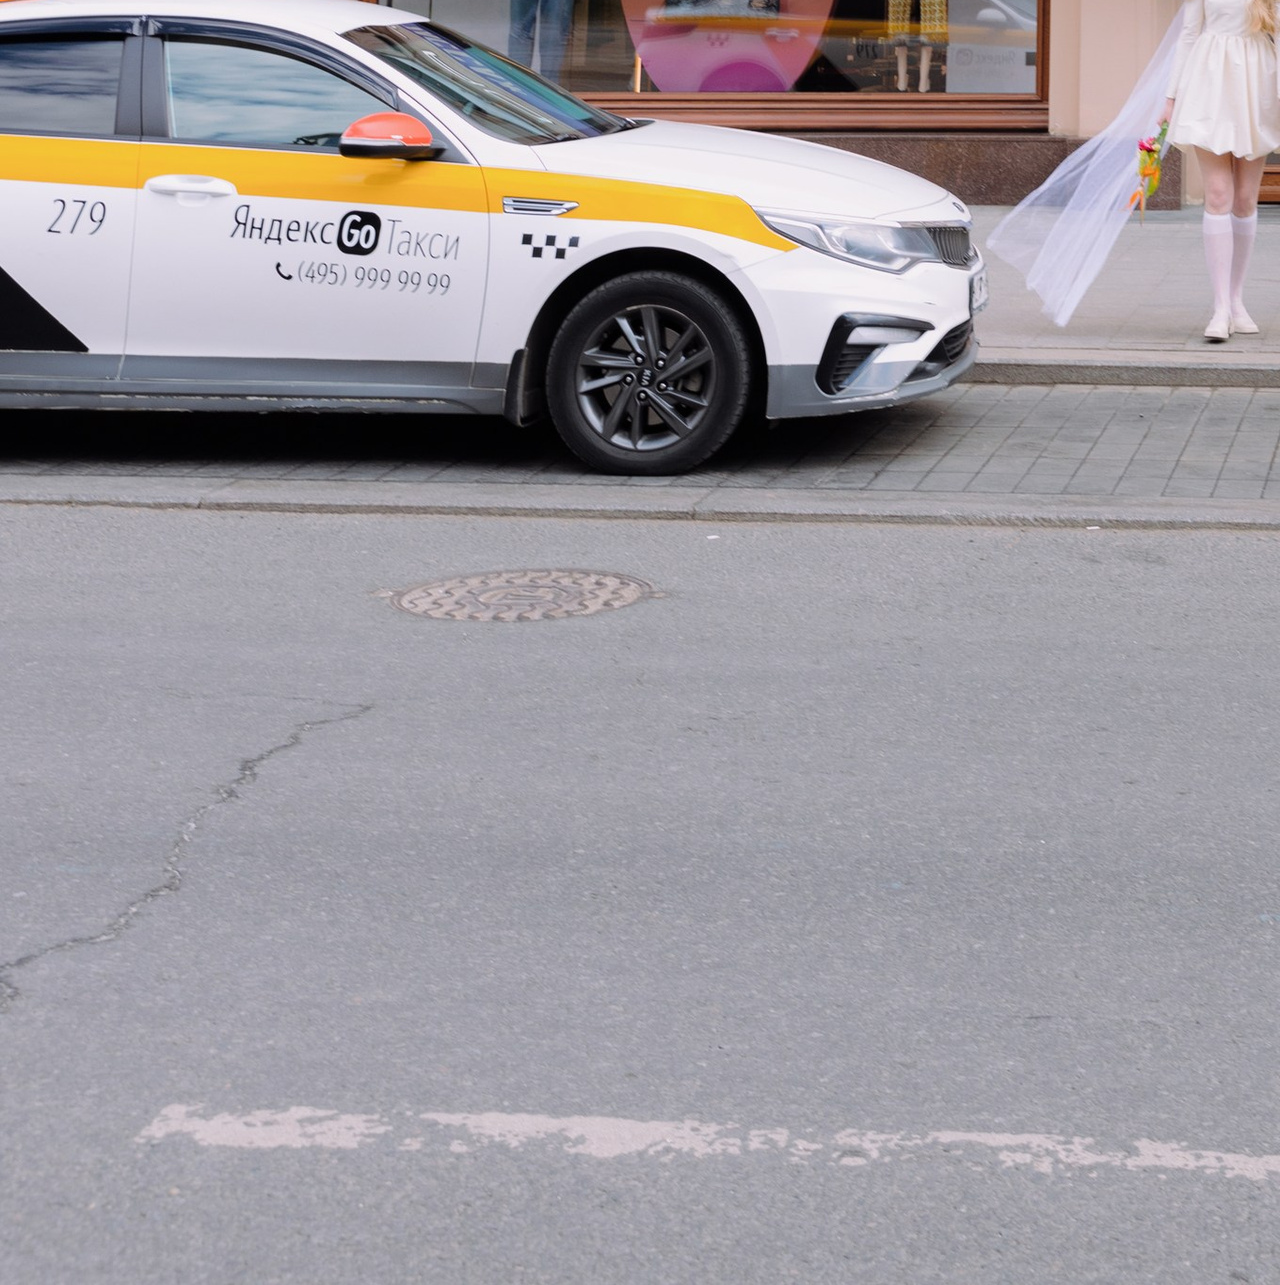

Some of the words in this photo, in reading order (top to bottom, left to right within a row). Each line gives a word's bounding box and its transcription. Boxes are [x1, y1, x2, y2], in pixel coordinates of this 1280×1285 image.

[47, 198, 106, 235] 279
[231, 204, 334, 245] Яндекс
[341, 214, 376, 249] Go
[387, 218, 460, 261] Такси
[298, 261, 347, 286] (495)
[355, 266, 391, 290] 999
[398, 270, 421, 293] 99
[427, 274, 450, 296] 99
